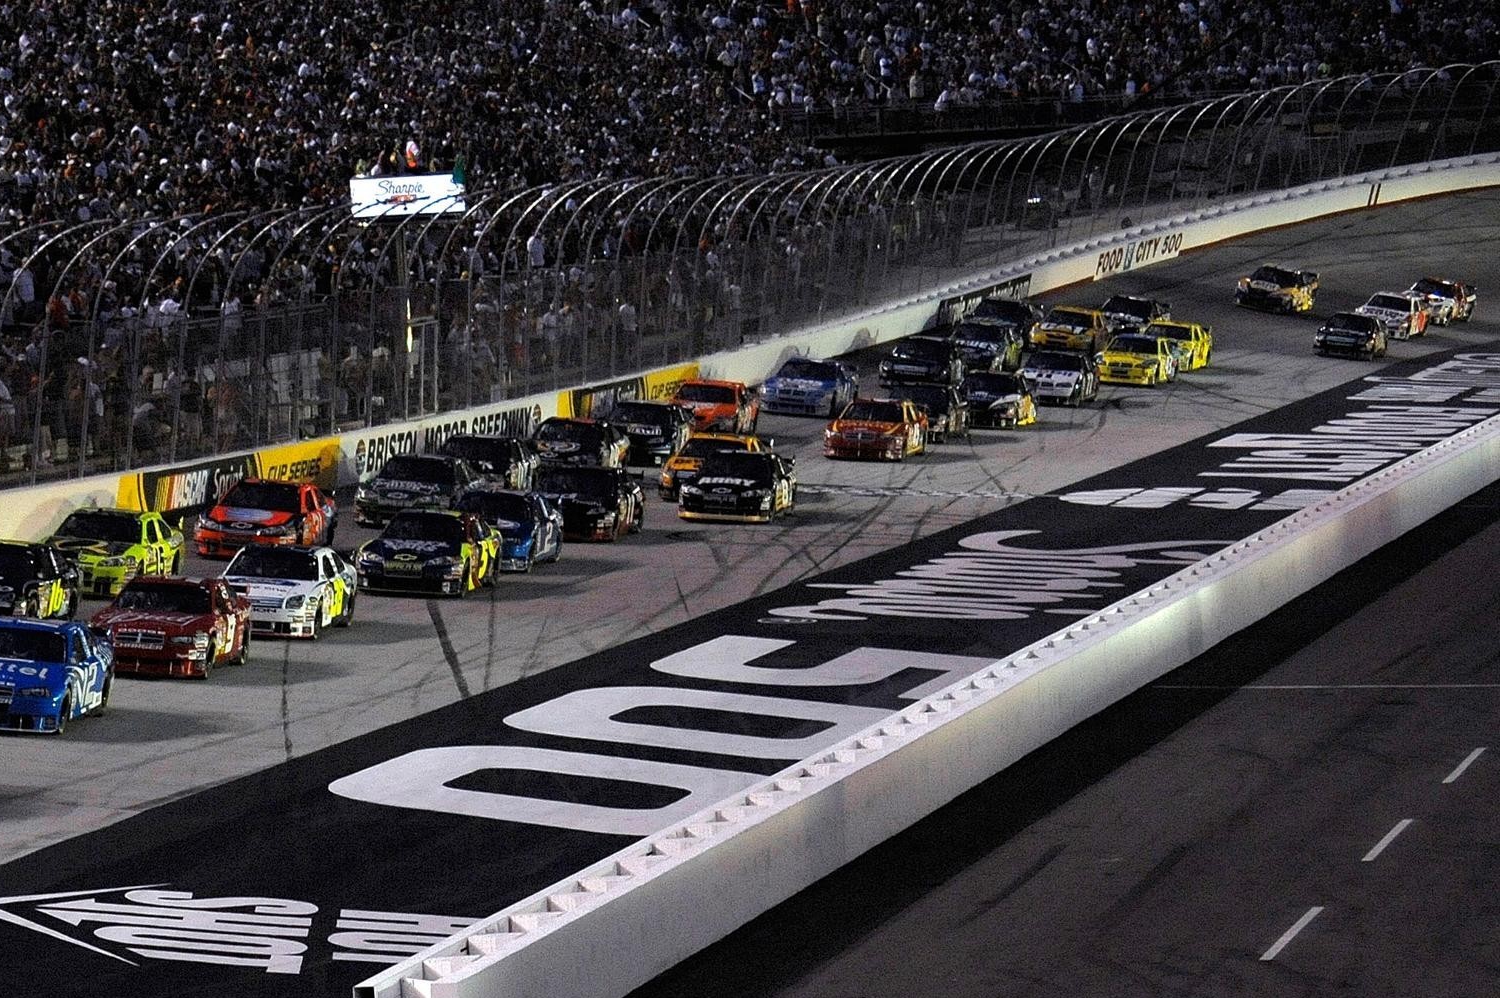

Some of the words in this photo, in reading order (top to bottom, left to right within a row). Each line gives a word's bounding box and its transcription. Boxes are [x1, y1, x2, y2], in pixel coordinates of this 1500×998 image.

[375, 179, 425, 196] Sharpie
[1095, 247, 1124, 276] FOOD
[1136, 237, 1162, 263] CITY
[1161, 233, 1183, 255] 500
[472, 406, 532, 438] SPEEDWAY
[1311, 404, 1500, 434] FOOD
[698, 476, 756, 487] ARMY
[1197, 449, 1408, 482] CITY
[173, 470, 208, 509] NASCAR
[267, 464, 289, 481] CUP
[289, 457, 323, 480] SERIES
[329, 634, 994, 836] 500
[33, 889, 321, 975] SHOT
